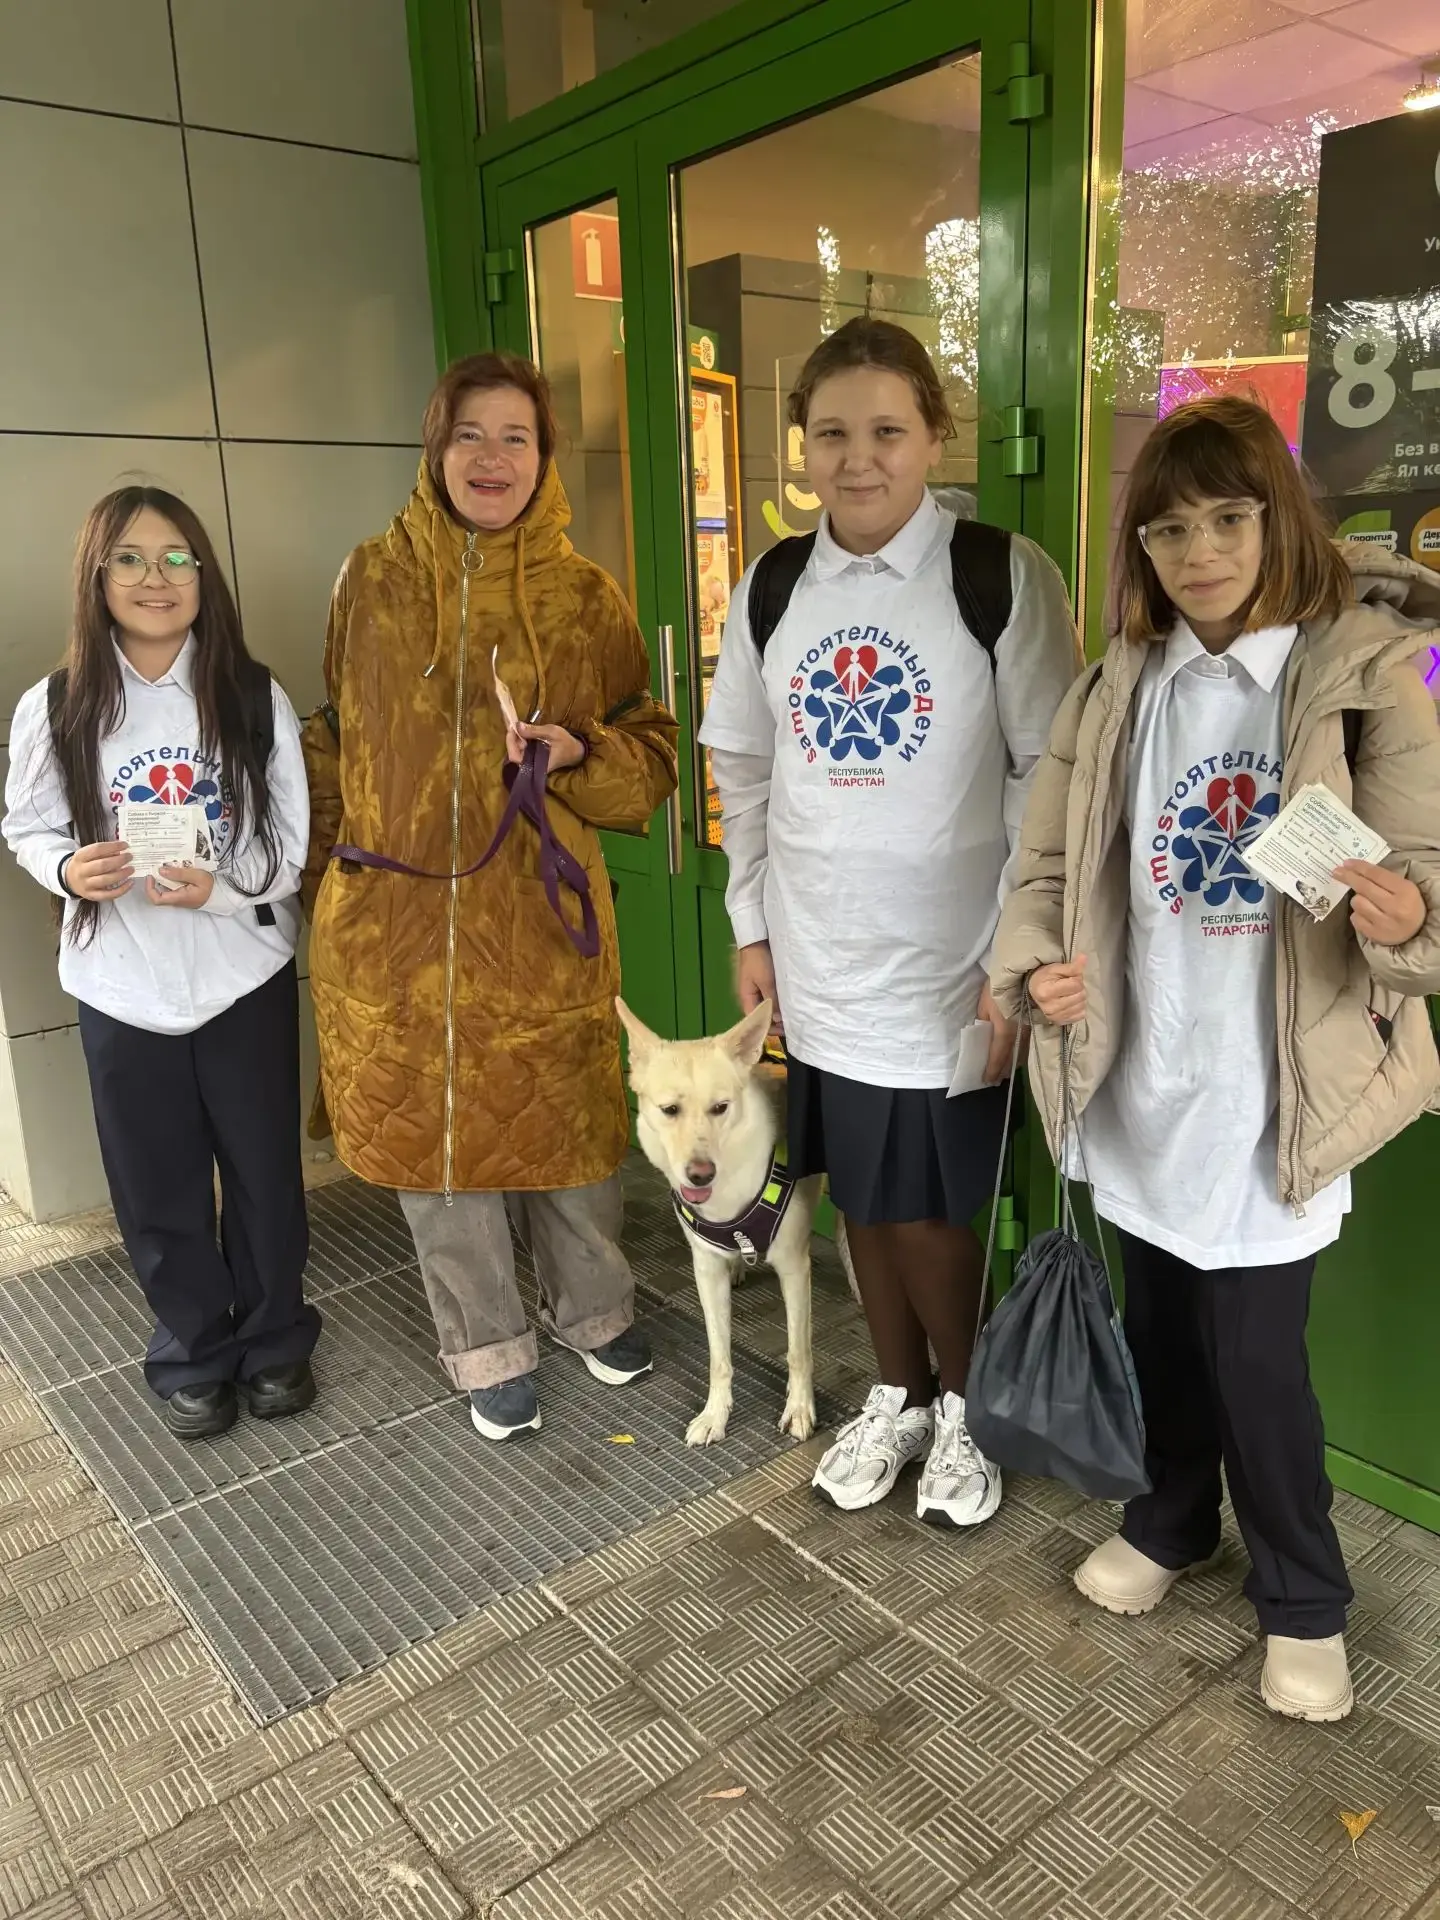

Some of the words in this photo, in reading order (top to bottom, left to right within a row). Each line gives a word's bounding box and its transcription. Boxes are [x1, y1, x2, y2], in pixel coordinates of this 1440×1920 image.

[1395, 443, 1424, 457] Без
[1397, 464, 1418, 478] Ял
[828, 768, 884, 776] РЕСПУБЛИКА
[829, 778, 885, 787] ТАТАРСТАН
[1201, 912, 1269, 925] РЕСПУБЛИКА
[1202, 924, 1270, 937] ТАТАРСТАН
